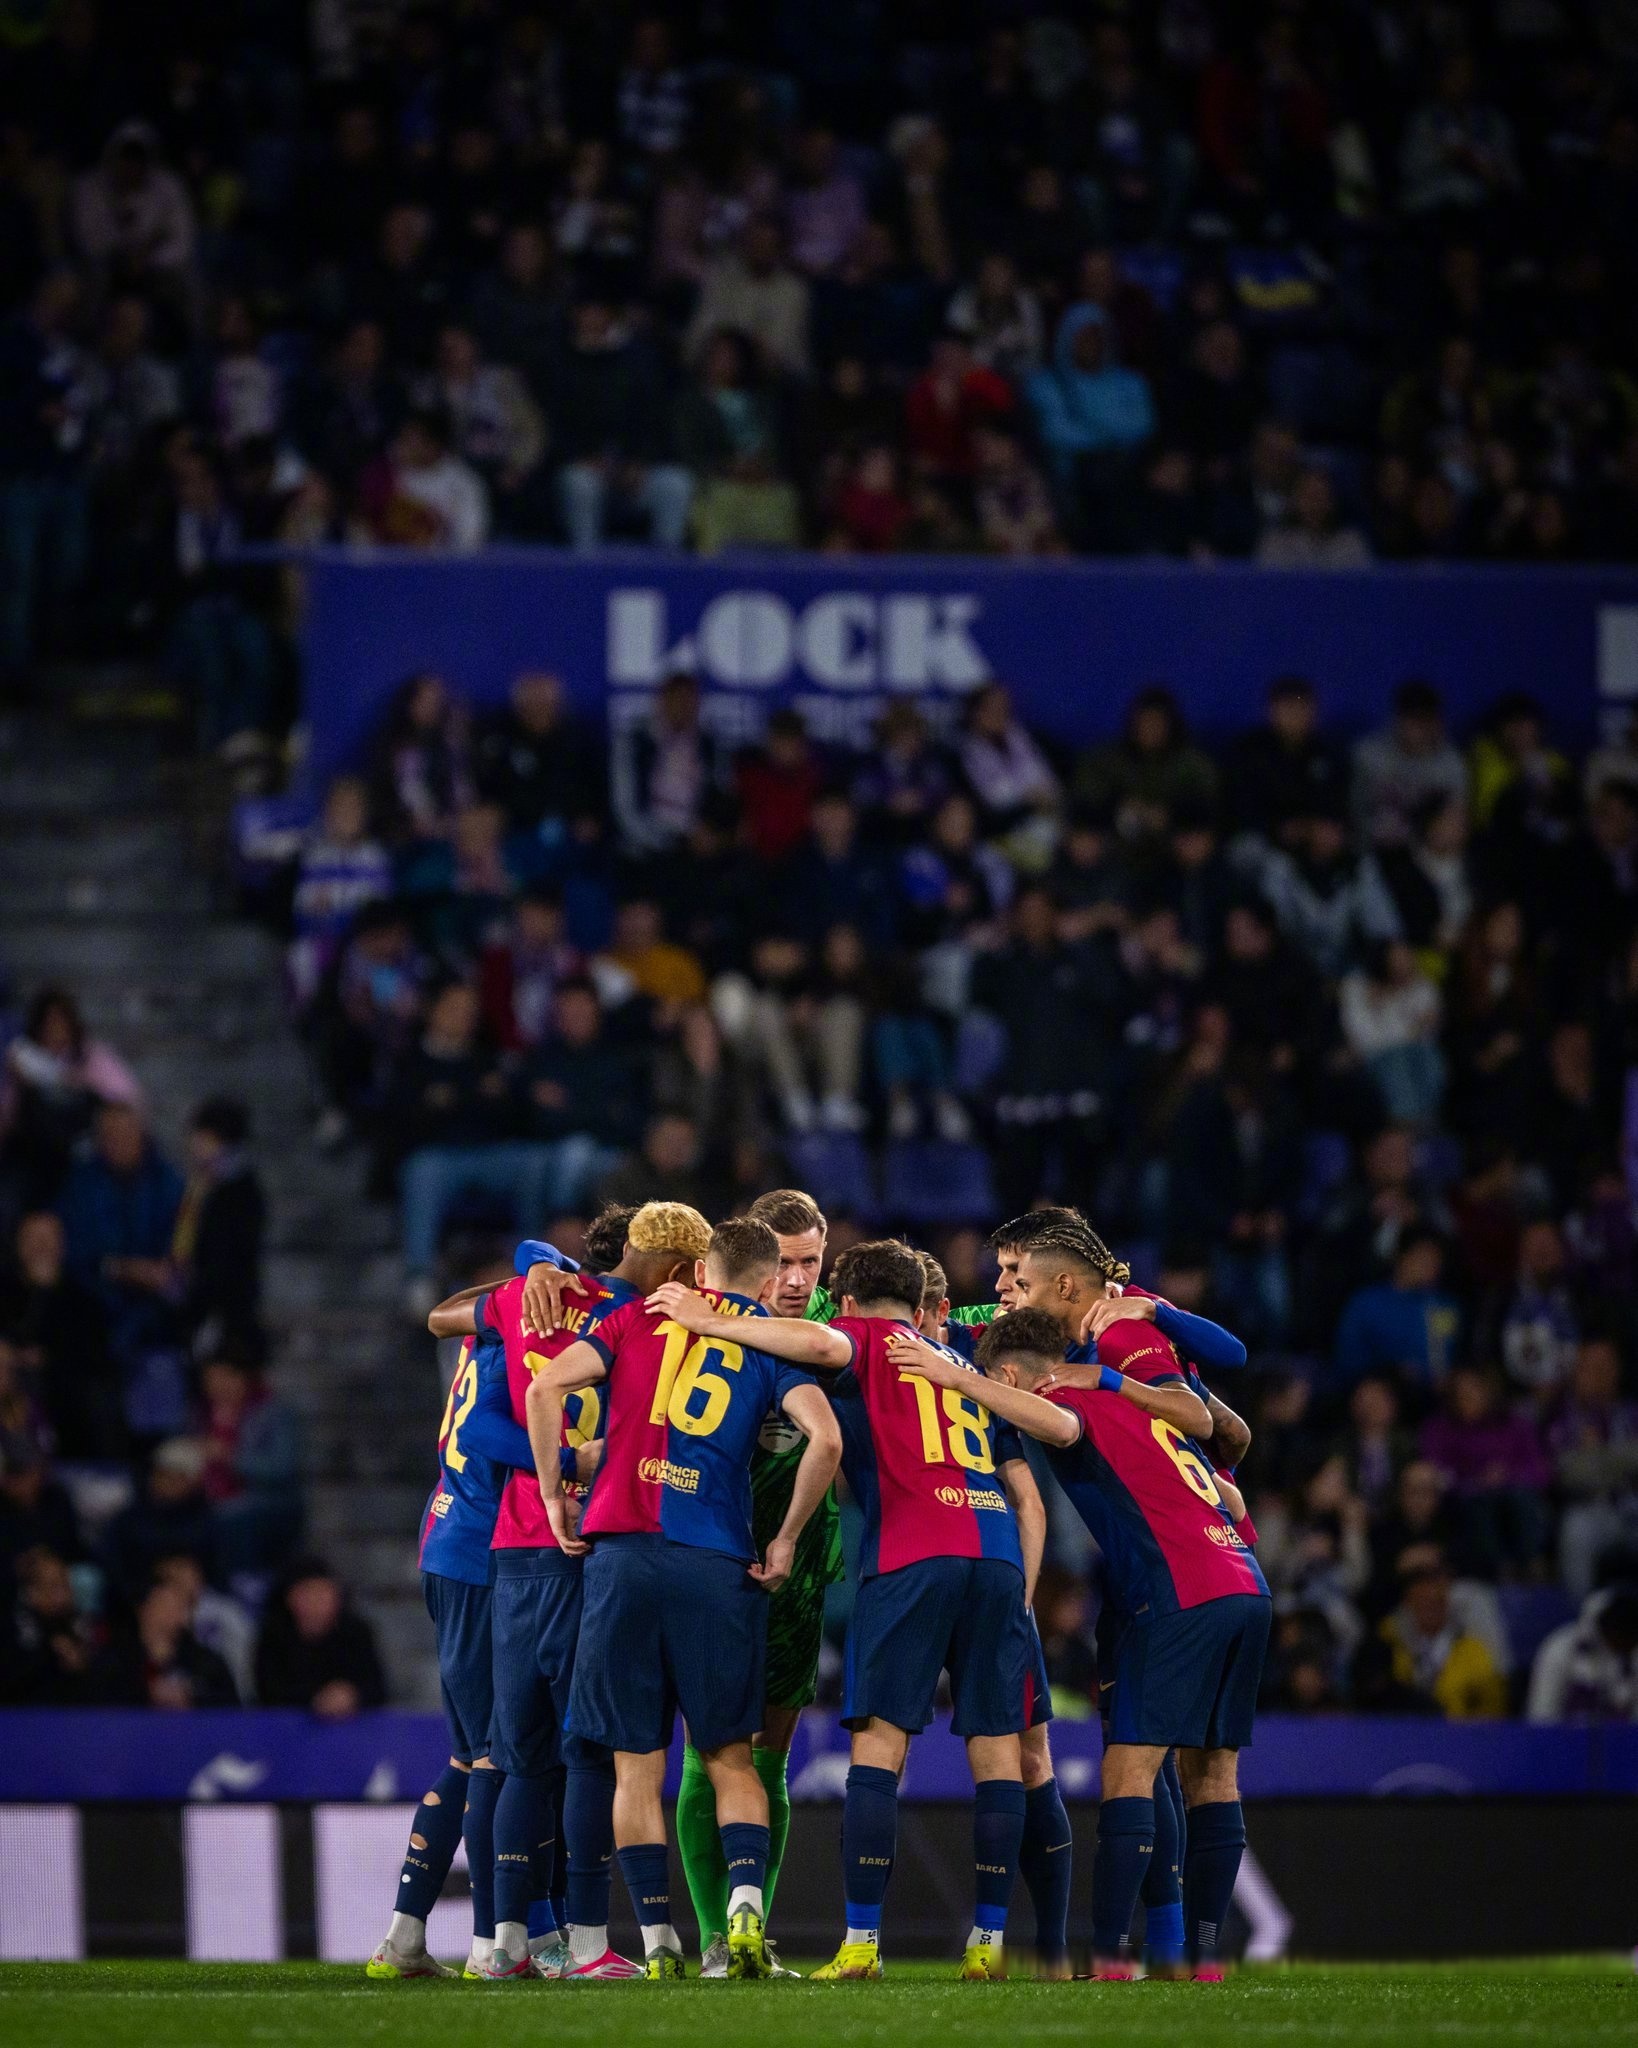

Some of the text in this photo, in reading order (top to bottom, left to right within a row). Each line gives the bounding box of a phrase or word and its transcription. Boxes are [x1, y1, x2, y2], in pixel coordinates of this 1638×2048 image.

[606, 586, 995, 692] LOCK
[438, 1344, 477, 1474] 12
[648, 1320, 743, 1437] 16
[898, 1372, 996, 1474] 18
[659, 1471, 698, 1490] ACNUR
[660, 1459, 701, 1480] UNHCR
[1151, 1418, 1220, 1506] 6
